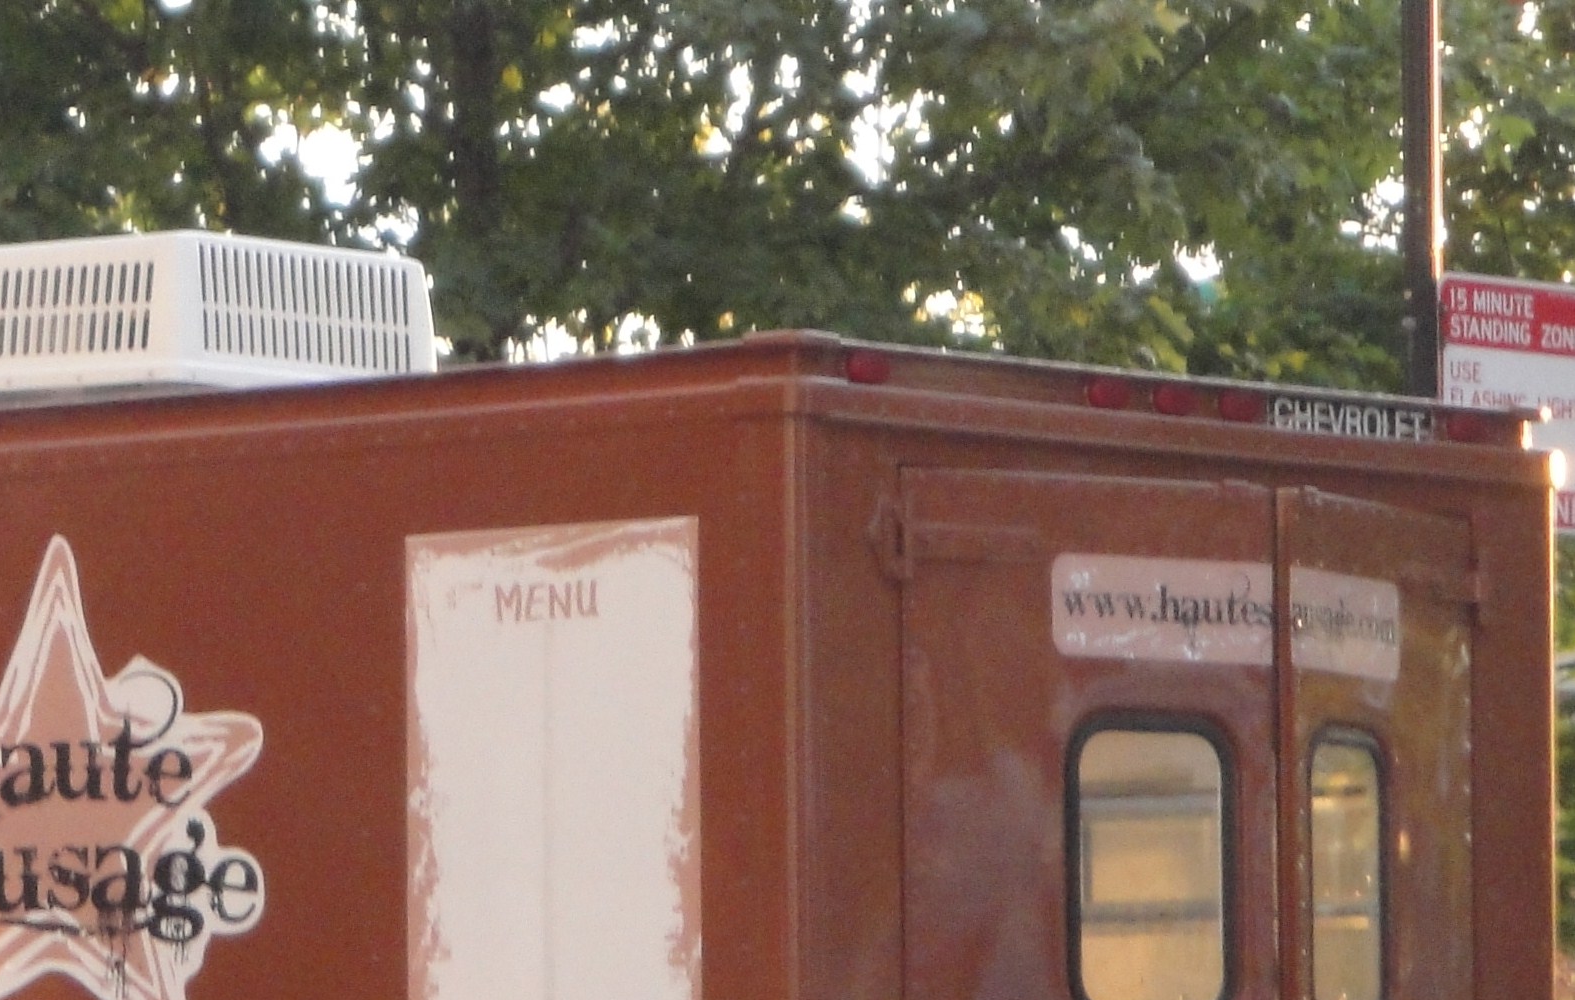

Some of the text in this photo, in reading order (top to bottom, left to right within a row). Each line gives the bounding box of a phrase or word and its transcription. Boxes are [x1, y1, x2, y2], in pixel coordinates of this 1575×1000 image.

[1449, 286, 1534, 319] 15 MINUTE
[1450, 313, 1531, 345] STANDING
[1450, 360, 1481, 384] USE
[1274, 398, 1426, 442] CHEVROLET
[494, 579, 598, 624] MENU
